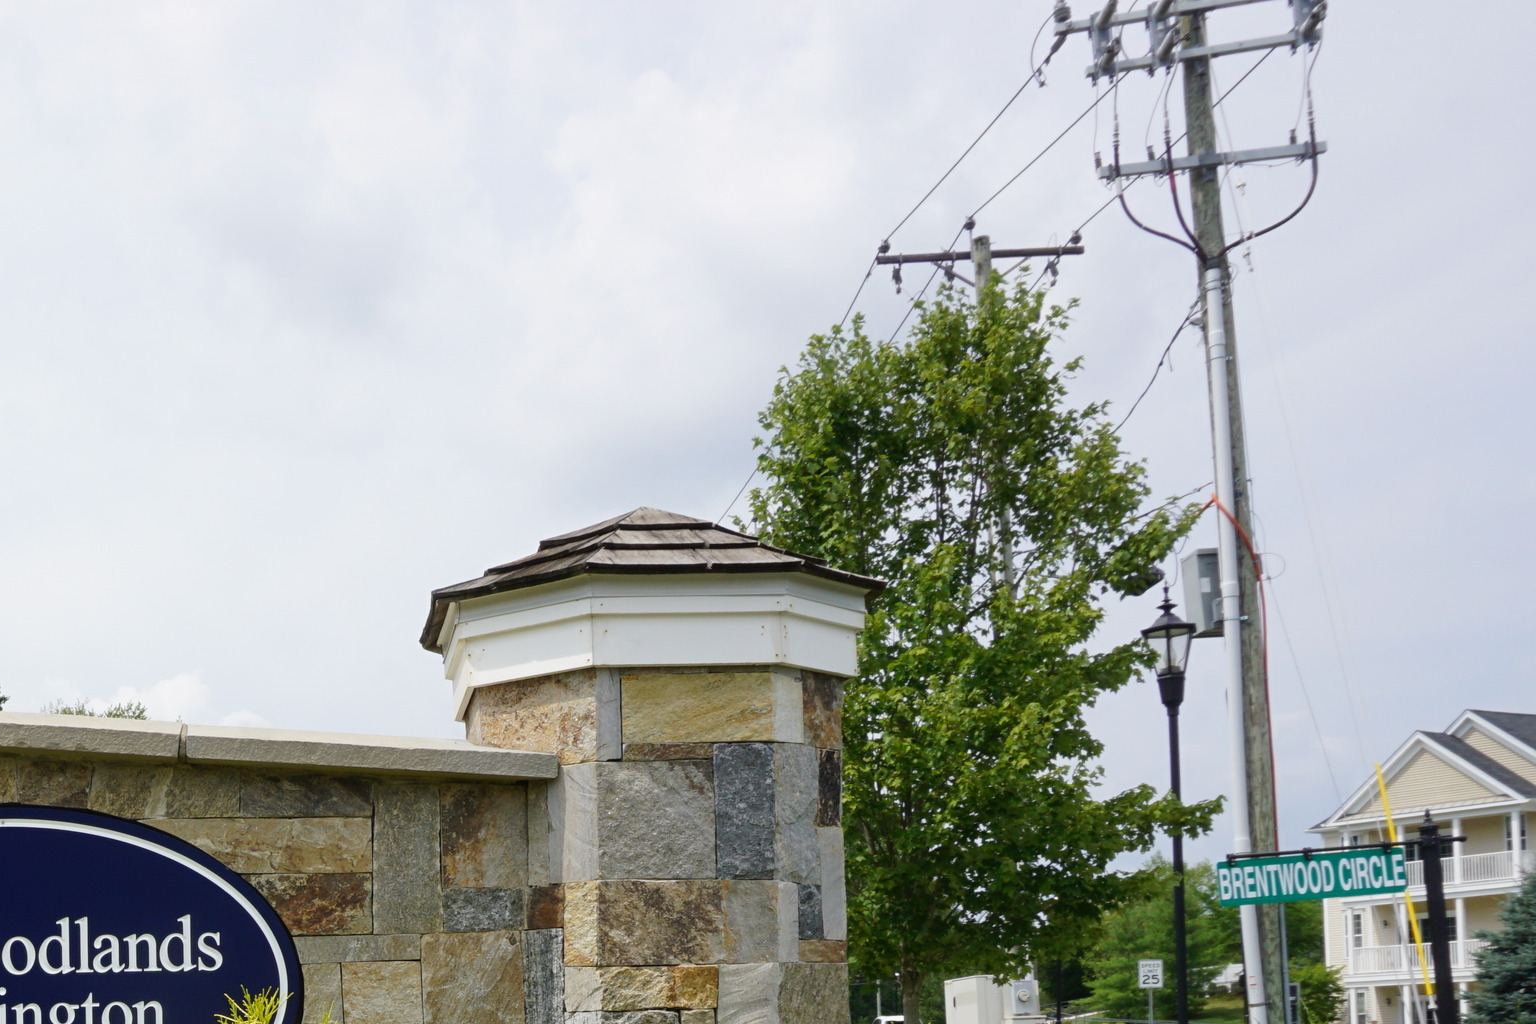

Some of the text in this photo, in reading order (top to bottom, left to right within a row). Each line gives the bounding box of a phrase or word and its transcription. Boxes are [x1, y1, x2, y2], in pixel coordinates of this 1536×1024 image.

[1218, 854, 1406, 900] BRENTWOOD CIRCLE
[1142, 974, 1160, 985] 25
